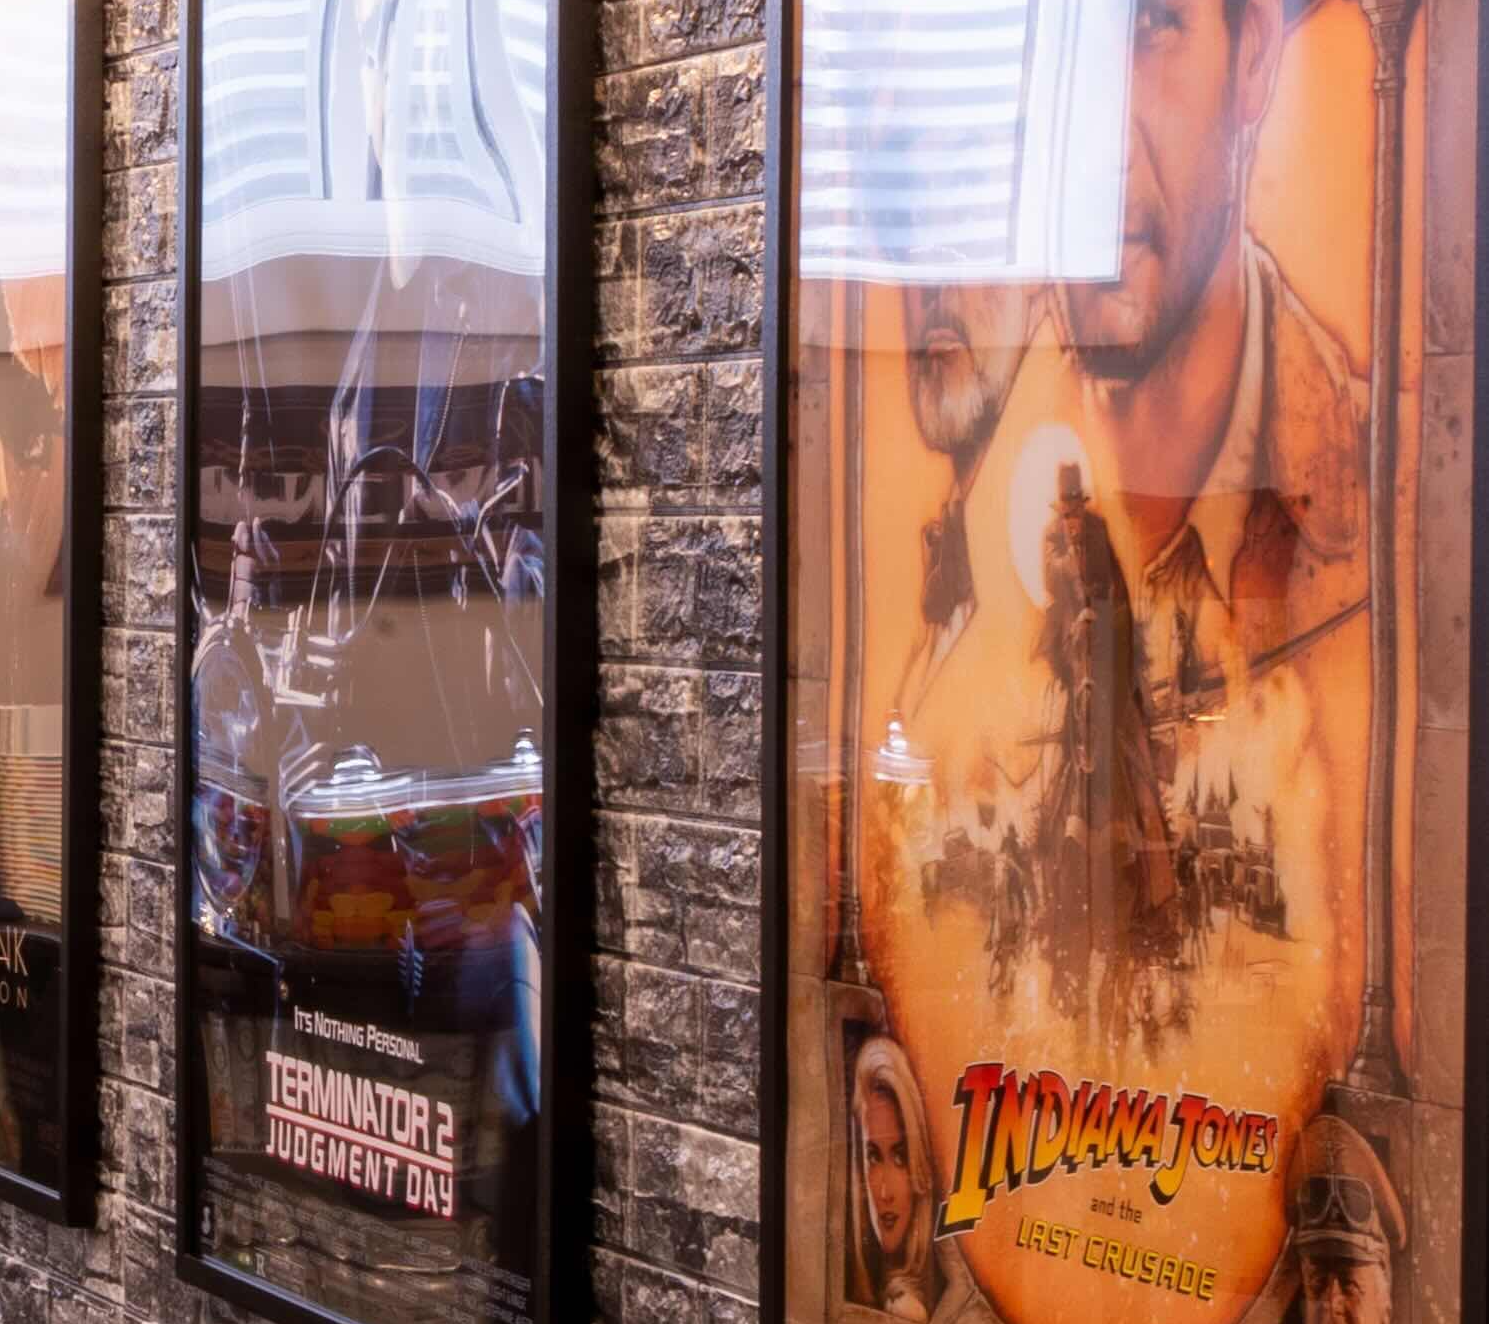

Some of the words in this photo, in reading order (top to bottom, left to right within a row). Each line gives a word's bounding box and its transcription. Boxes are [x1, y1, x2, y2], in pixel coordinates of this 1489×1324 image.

[314, 1012, 364, 1049] NOTHING
[265, 1050, 430, 1151] TERMINATOR
[436, 1102, 454, 1160] 2
[934, 1061, 1168, 1241] INDIANA
[1149, 1093, 1278, 1205] JONES
[265, 1118, 398, 1198] JUDGMENT
[406, 1164, 454, 1217] DAY
[1091, 1196, 1115, 1218] and
[1120, 1199, 1142, 1223] the
[1016, 1216, 1080, 1261] LAST
[1083, 1234, 1218, 1302] CRUSADE
